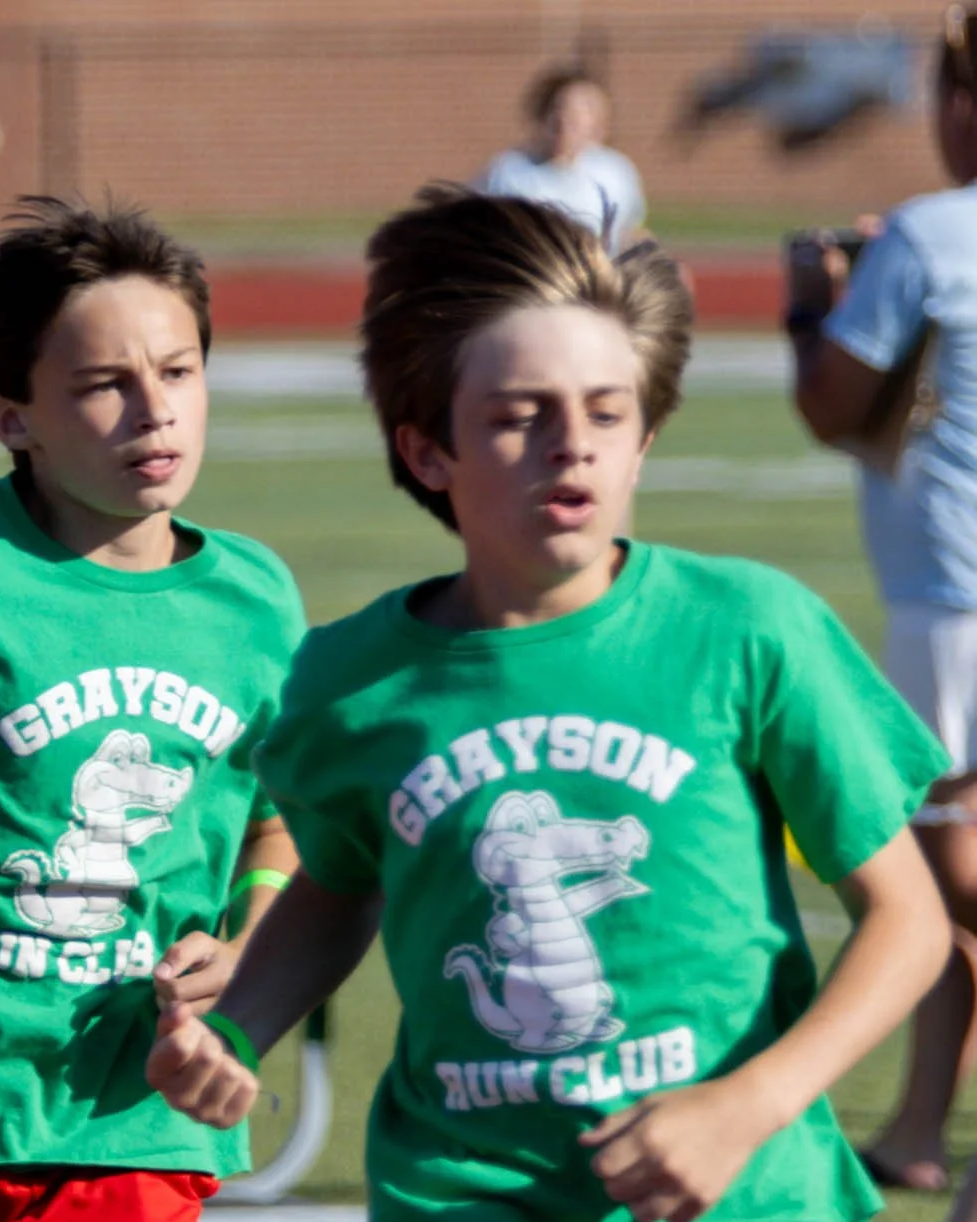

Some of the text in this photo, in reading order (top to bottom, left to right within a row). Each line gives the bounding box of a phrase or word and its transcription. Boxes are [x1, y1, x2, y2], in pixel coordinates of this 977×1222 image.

[388, 714, 696, 846] GRAYSON
[434, 1025, 697, 1110] RUN CLUB
